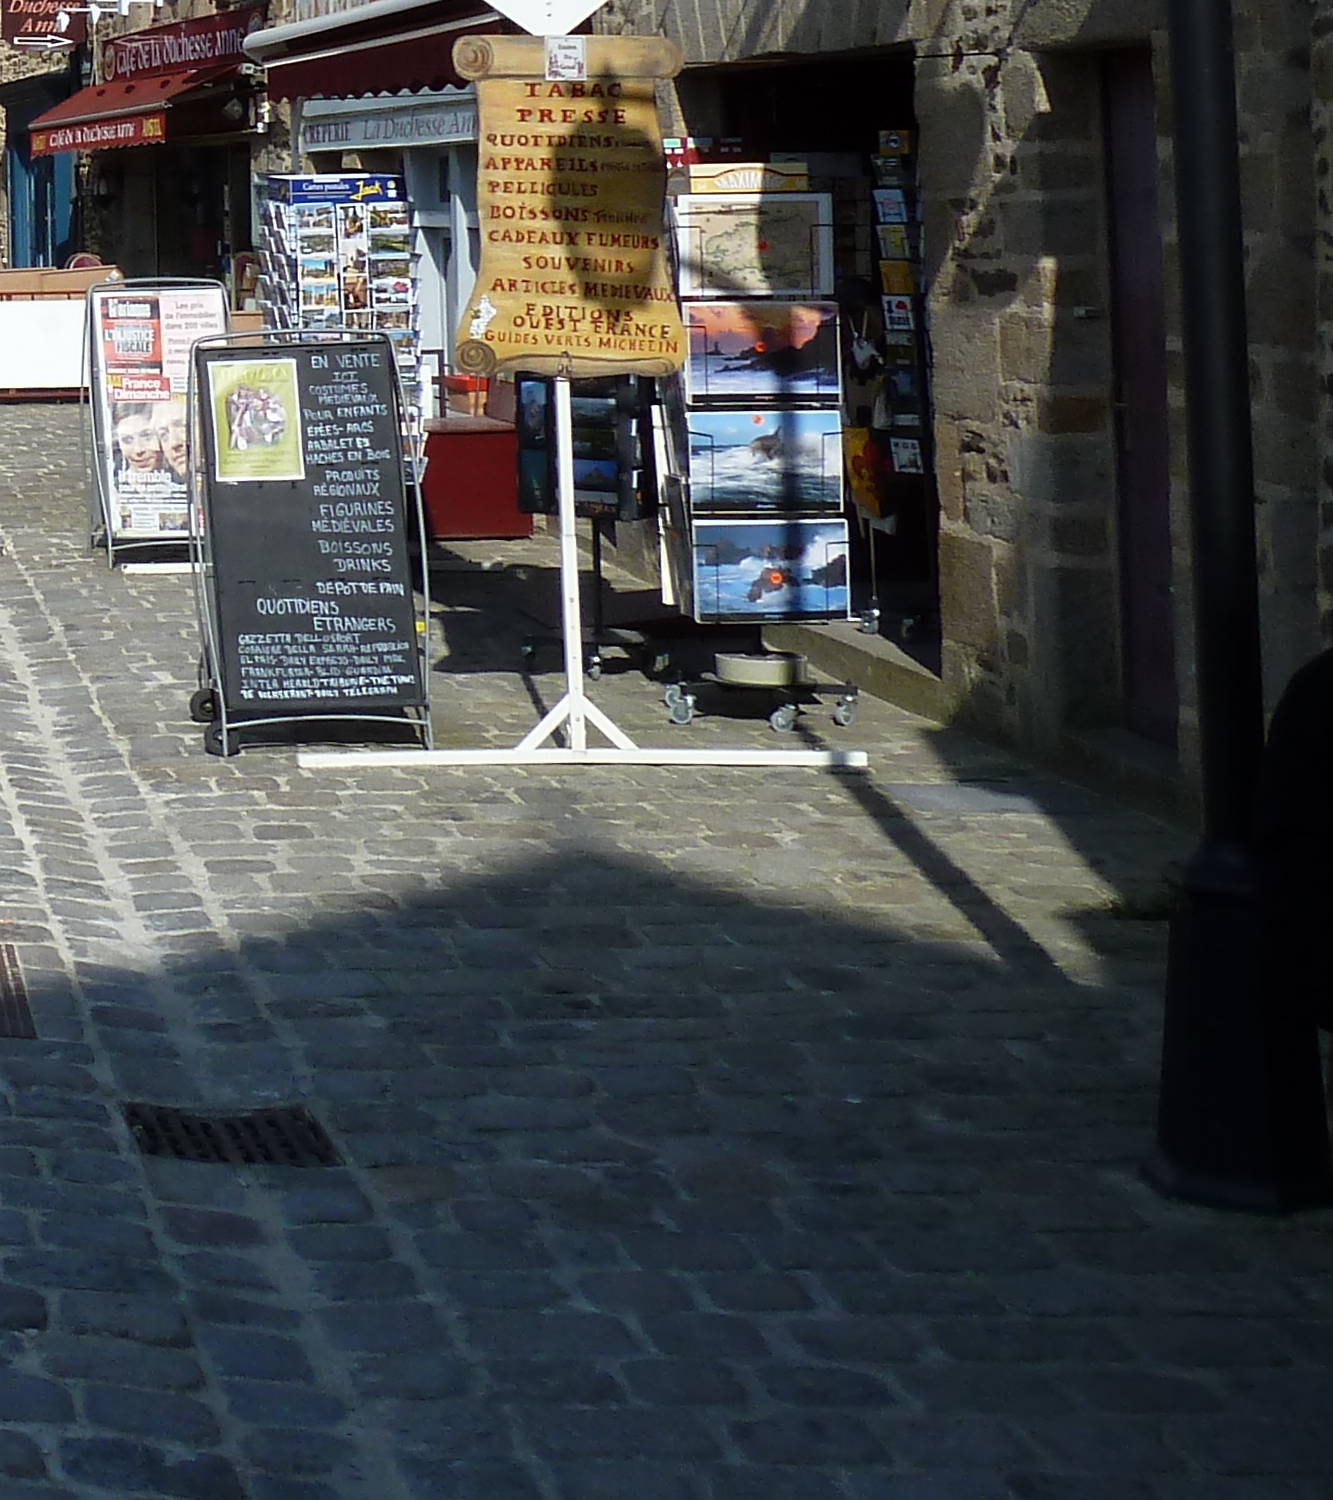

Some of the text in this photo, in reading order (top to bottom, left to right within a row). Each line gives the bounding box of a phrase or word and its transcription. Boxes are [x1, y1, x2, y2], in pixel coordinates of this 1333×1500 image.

[524, 82, 622, 98] TABAC
[516, 108, 626, 124] PRESSE
[303, 121, 351, 144] CREPERIE
[363, 119, 380, 140] La
[382, 108, 445, 139] Duchesse
[486, 133, 615, 148] QUOTIDIENS
[485, 157, 599, 172] APPAREILS
[487, 180, 599, 197] PELLICULES
[490, 202, 589, 223] BOISSONS
[488, 230, 660, 250] CADEAUX FUMEURS
[522, 255, 635, 274] SOUVENIRS
[490, 278, 673, 302] ARTICLES MEDIEVAUX
[525, 303, 634, 323] EDITIONS
[513, 316, 671, 338] OUEST FRANCE
[117, 341, 151, 353] FISCALE
[484, 330, 679, 354] GUIDES VERTS MICHELIN
[311, 353, 381, 369] EN VENTE
[122, 377, 161, 389] France
[332, 371, 359, 383] ICI
[114, 388, 170, 400] Dimanche
[309, 383, 368, 396] COSTUMES
[303, 404, 388, 421] POUR ENFANTS
[306, 451, 344, 465] HACHES
[347, 450, 362, 461] EN
[325, 467, 380, 481] PRODUITS
[319, 500, 394, 517] FIGURINES
[318, 539, 393, 556] BOISSONS
[334, 558, 391, 572] DRINKS
[380, 582, 405, 596] PAIN
[256, 598, 340, 615] QUOTIDIENS
